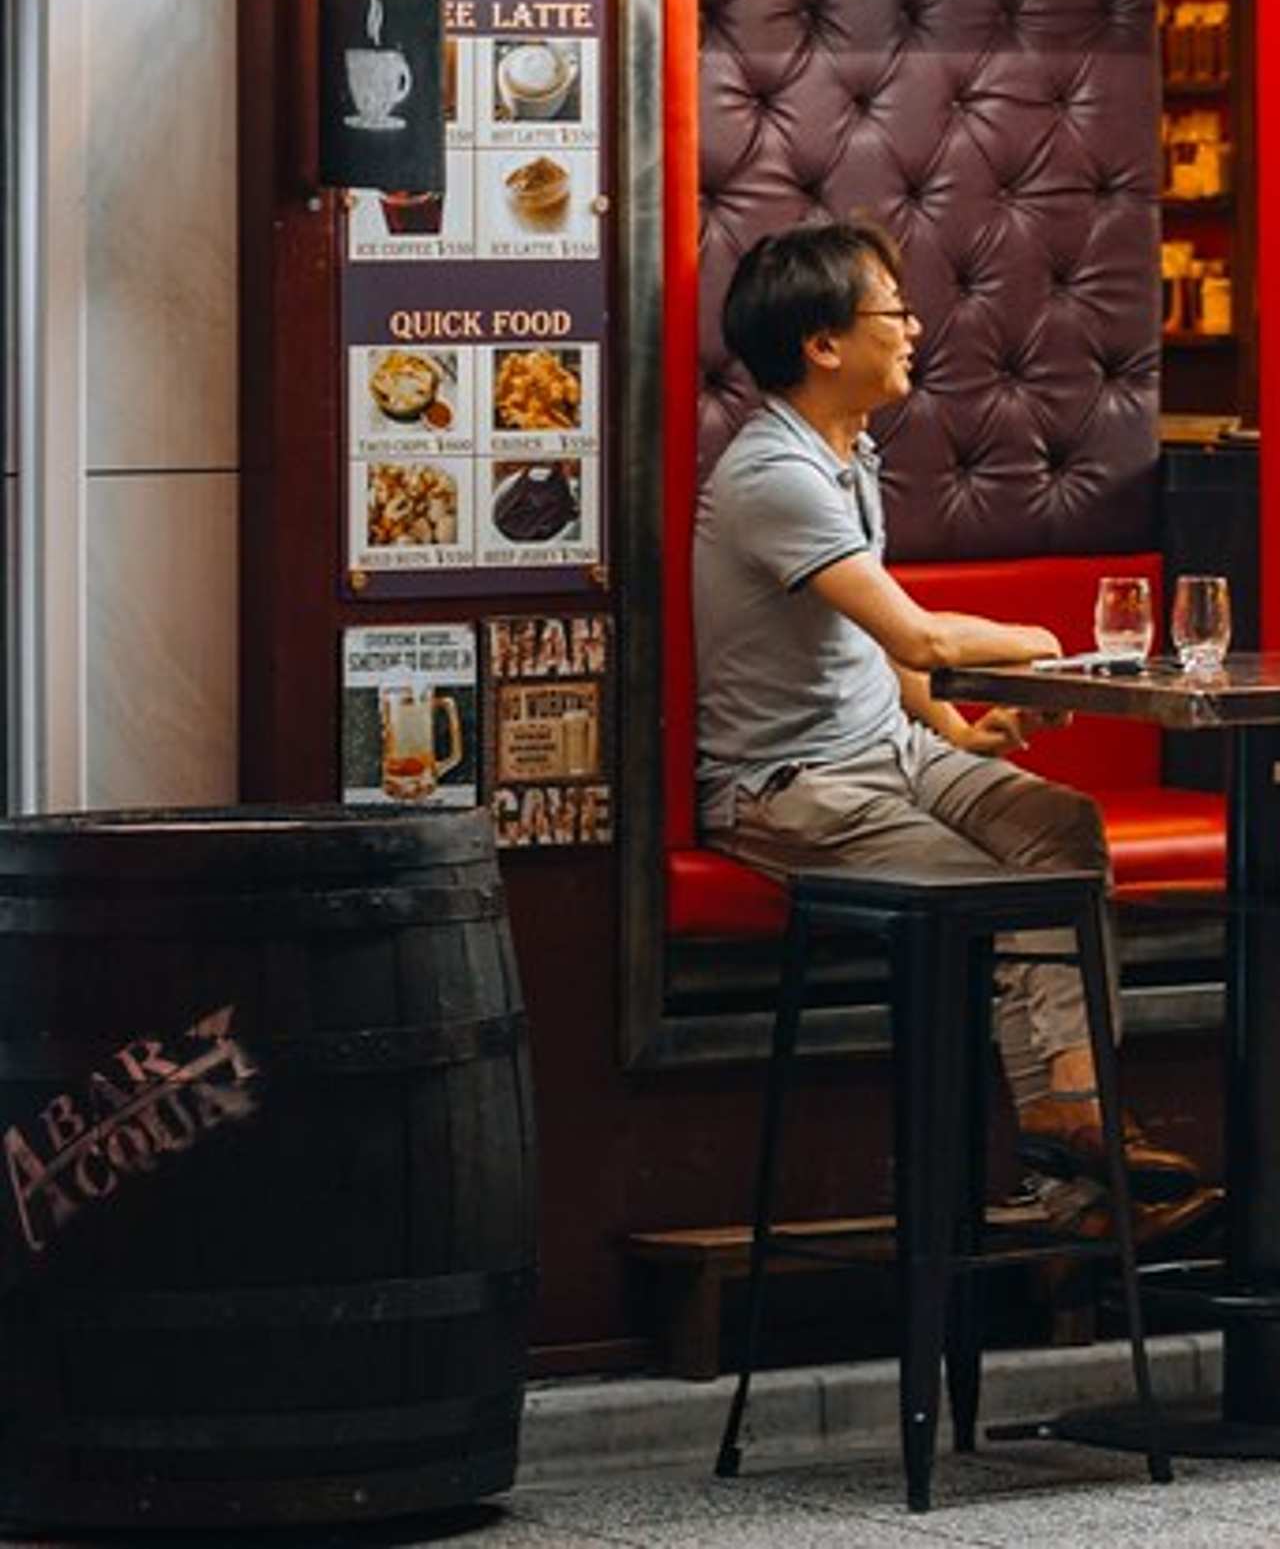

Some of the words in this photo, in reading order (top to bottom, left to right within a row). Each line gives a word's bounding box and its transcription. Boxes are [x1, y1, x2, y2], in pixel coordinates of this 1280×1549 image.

[492, 3, 593, 28] LATTE
[390, 311, 481, 338] QUICK
[492, 310, 571, 336] FOOD
[490, 618, 605, 677] MAN
[493, 787, 612, 846] CAVE
